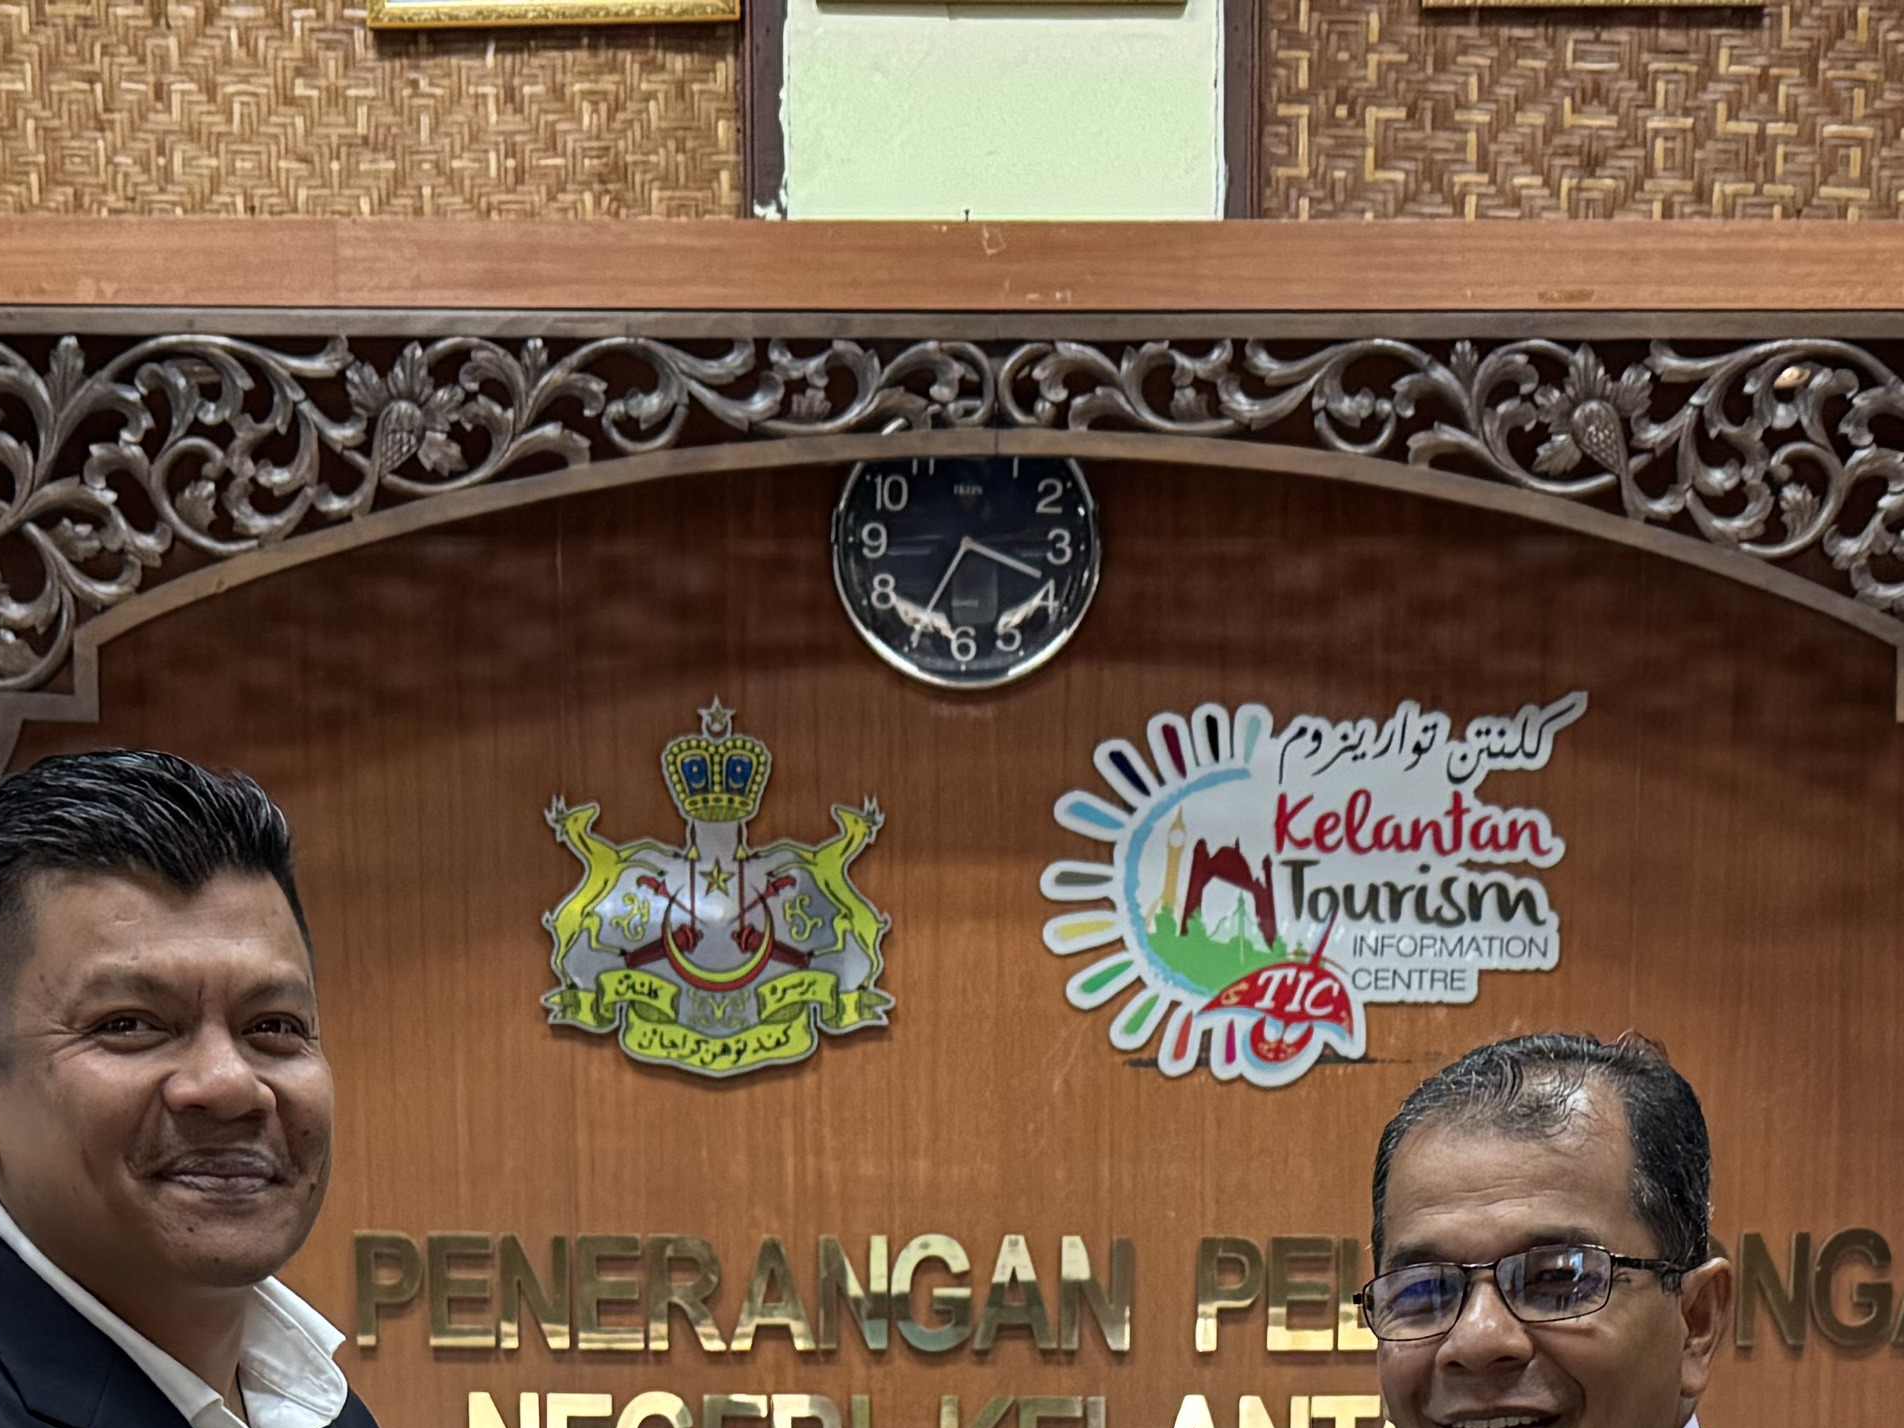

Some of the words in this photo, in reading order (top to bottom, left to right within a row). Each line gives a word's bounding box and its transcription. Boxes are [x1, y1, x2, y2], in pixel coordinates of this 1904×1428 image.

[873, 474, 909, 511] 10
[1035, 478, 1064, 514] 2
[861, 522, 888, 558] 9
[1046, 528, 1073, 565] 3
[871, 573, 895, 609] 8
[1036, 578, 1060, 616] 4
[950, 626, 977, 662] 6
[996, 616, 1022, 651] 5
[1275, 789, 1554, 857] Kelantan
[1280, 858, 1548, 927] Tourism
[1352, 935, 1549, 960] INFORMATION
[1254, 967, 1340, 1016] TIC
[1351, 968, 1467, 992] CENTRE
[353, 1228, 1132, 1353] PENERANGAN
